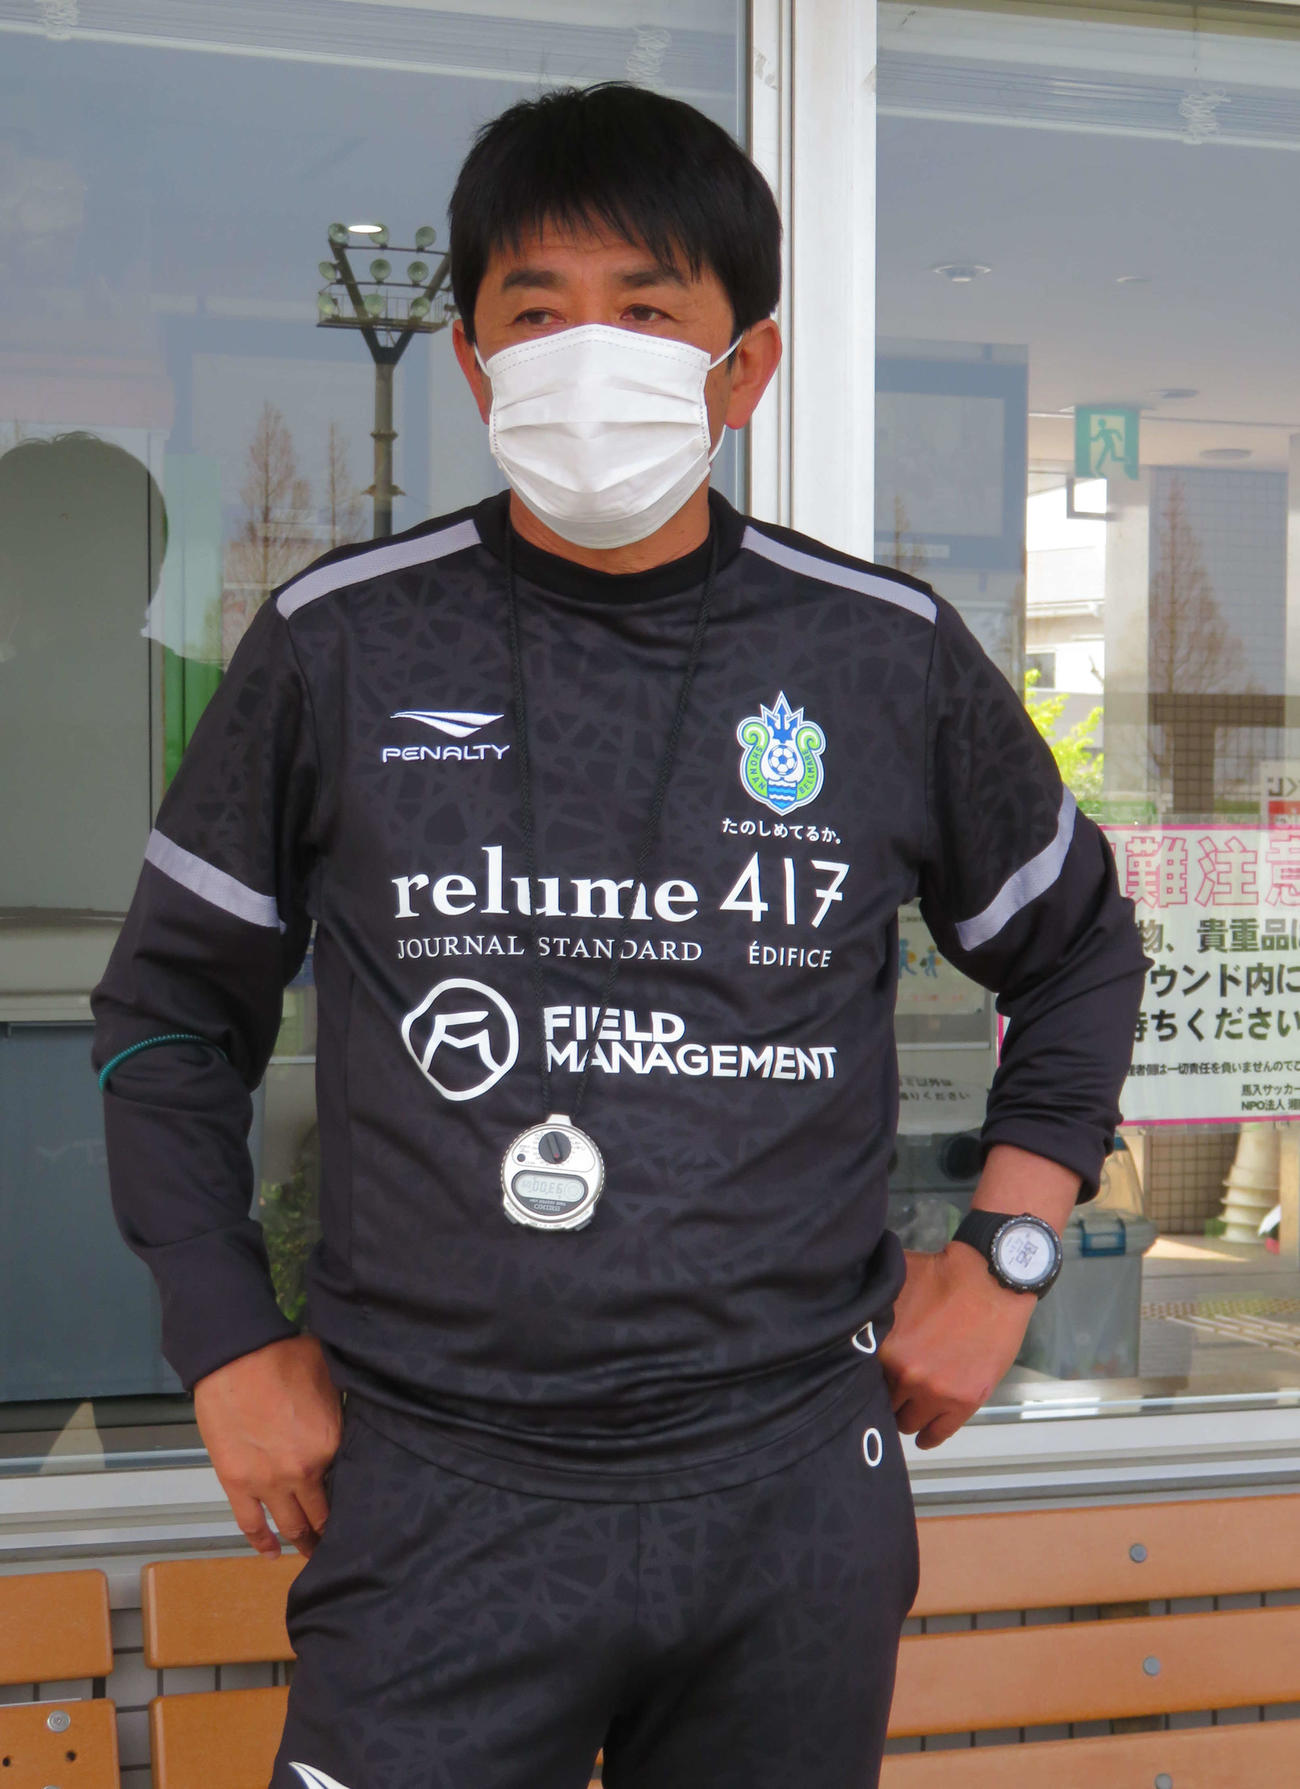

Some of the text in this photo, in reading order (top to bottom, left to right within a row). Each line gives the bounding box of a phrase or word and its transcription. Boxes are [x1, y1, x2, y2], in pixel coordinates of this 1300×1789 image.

[382, 744, 511, 763] PENALTY
[722, 818, 841, 845] たのしめてるか。
[391, 845, 699, 921] relume
[719, 851, 850, 928] 417
[1110, 836, 1300, 908] 難注意
[397, 935, 703, 961] JOURNAL STANDARD
[748, 940, 832, 968] ÉDIFICE
[543, 1005, 686, 1043] FIELD
[545, 1040, 837, 1080] MANAGEMENT
